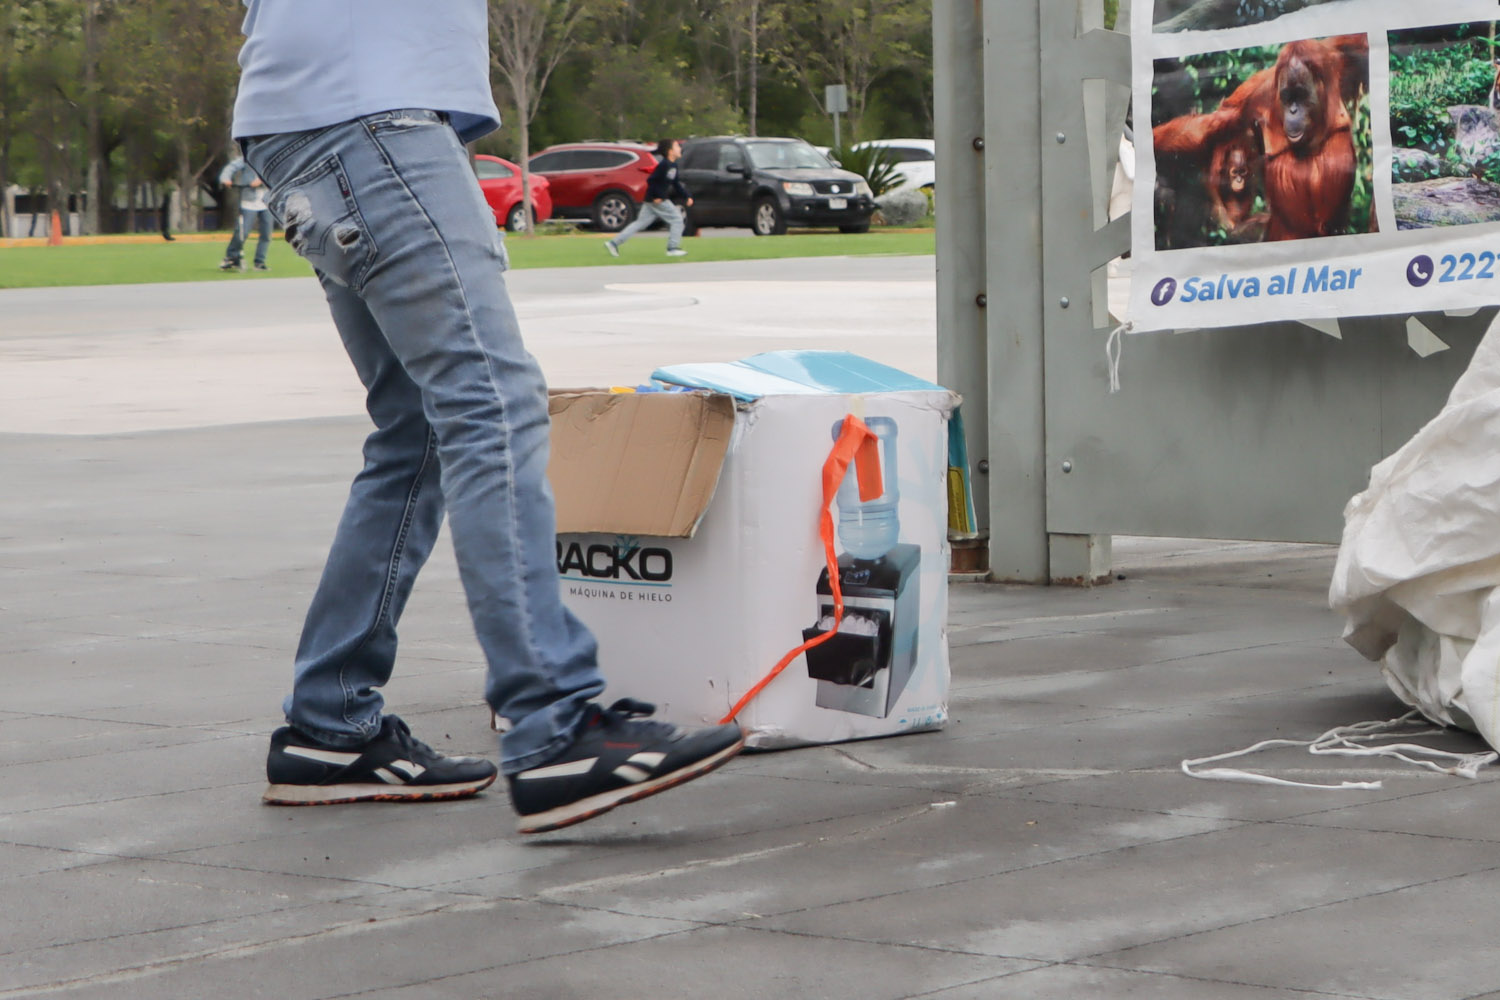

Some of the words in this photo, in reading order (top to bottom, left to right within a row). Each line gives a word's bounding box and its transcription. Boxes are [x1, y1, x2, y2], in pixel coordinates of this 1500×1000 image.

[1179, 274, 1261, 304] Salva
[1267, 267, 1297, 296] al
[1302, 265, 1363, 294] Mar
[569, 586, 616, 599] MÁQUINA
[619, 591, 634, 601] DE
[638, 592, 673, 603] HIELO
